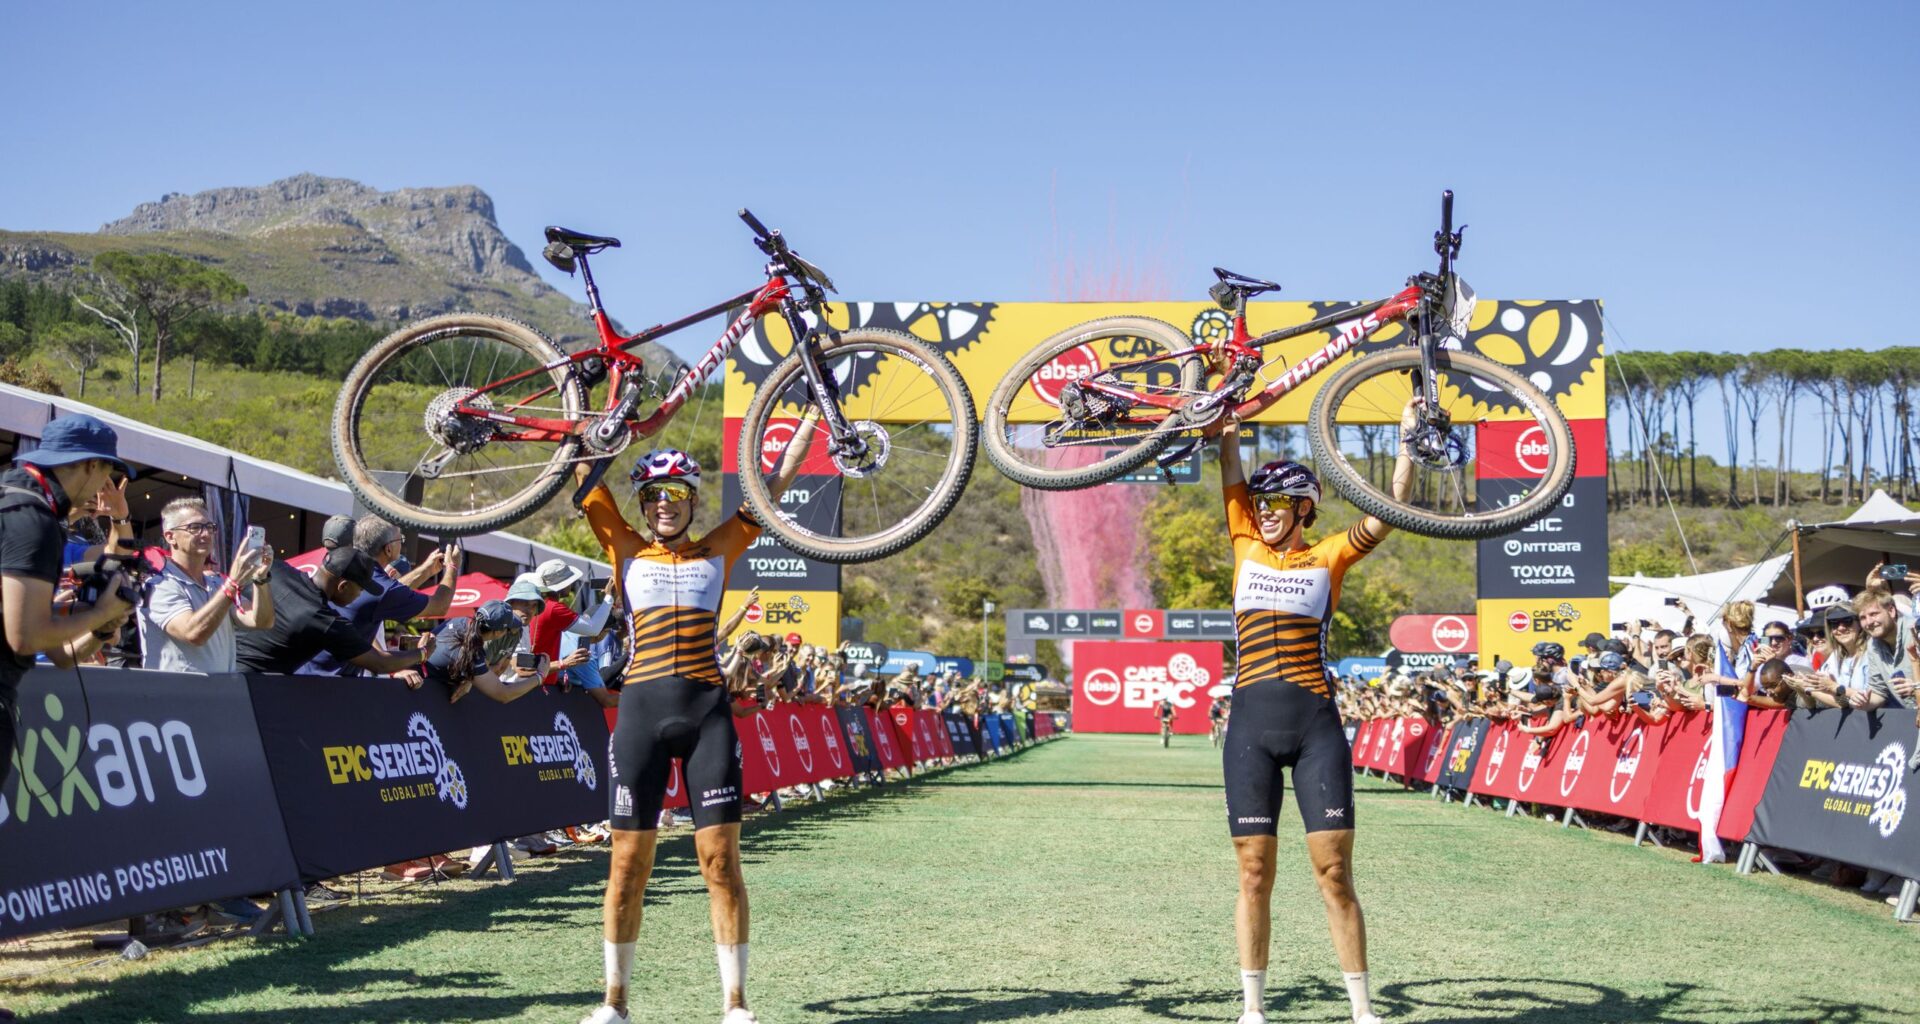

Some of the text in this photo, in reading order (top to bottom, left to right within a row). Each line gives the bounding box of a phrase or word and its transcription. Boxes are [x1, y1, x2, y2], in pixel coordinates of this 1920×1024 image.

[1109, 336, 1166, 358] CAP
[1040, 357, 1091, 380] absa
[763, 436, 788, 452] abs
[1522, 440, 1550, 456] abs
[1523, 542, 1547, 552] NTT
[748, 558, 807, 571] TOYOTA
[1510, 565, 1575, 577] TOYOTA
[1248, 582, 1306, 595] maxon
[766, 610, 802, 623] EPIC
[1533, 610, 1556, 618] CAPE
[1436, 624, 1465, 639] absa
[1533, 618, 1573, 632] EPIC
[935, 660, 958, 672] IC
[1401, 654, 1456, 666] TOYOTA
[1124, 666, 1167, 681] CAPE
[1088, 680, 1196, 708] absa EPIC
[501, 735, 533, 766] EPIC
[529, 734, 575, 764] SERIES
[0, 715, 207, 824] xxaro
[323, 741, 436, 784] EPIC SERIES
[538, 768, 576, 782] GLOBAL MTB
[1799, 759, 1891, 800] EPIC SERIES
[380, 783, 436, 802] GLOBAL MTB
[703, 786, 735, 798] SPIER
[1823, 797, 1872, 817] GLOBAL MTB
[1238, 816, 1272, 824] maxon
[115, 848, 229, 897] POSSIBILITY
